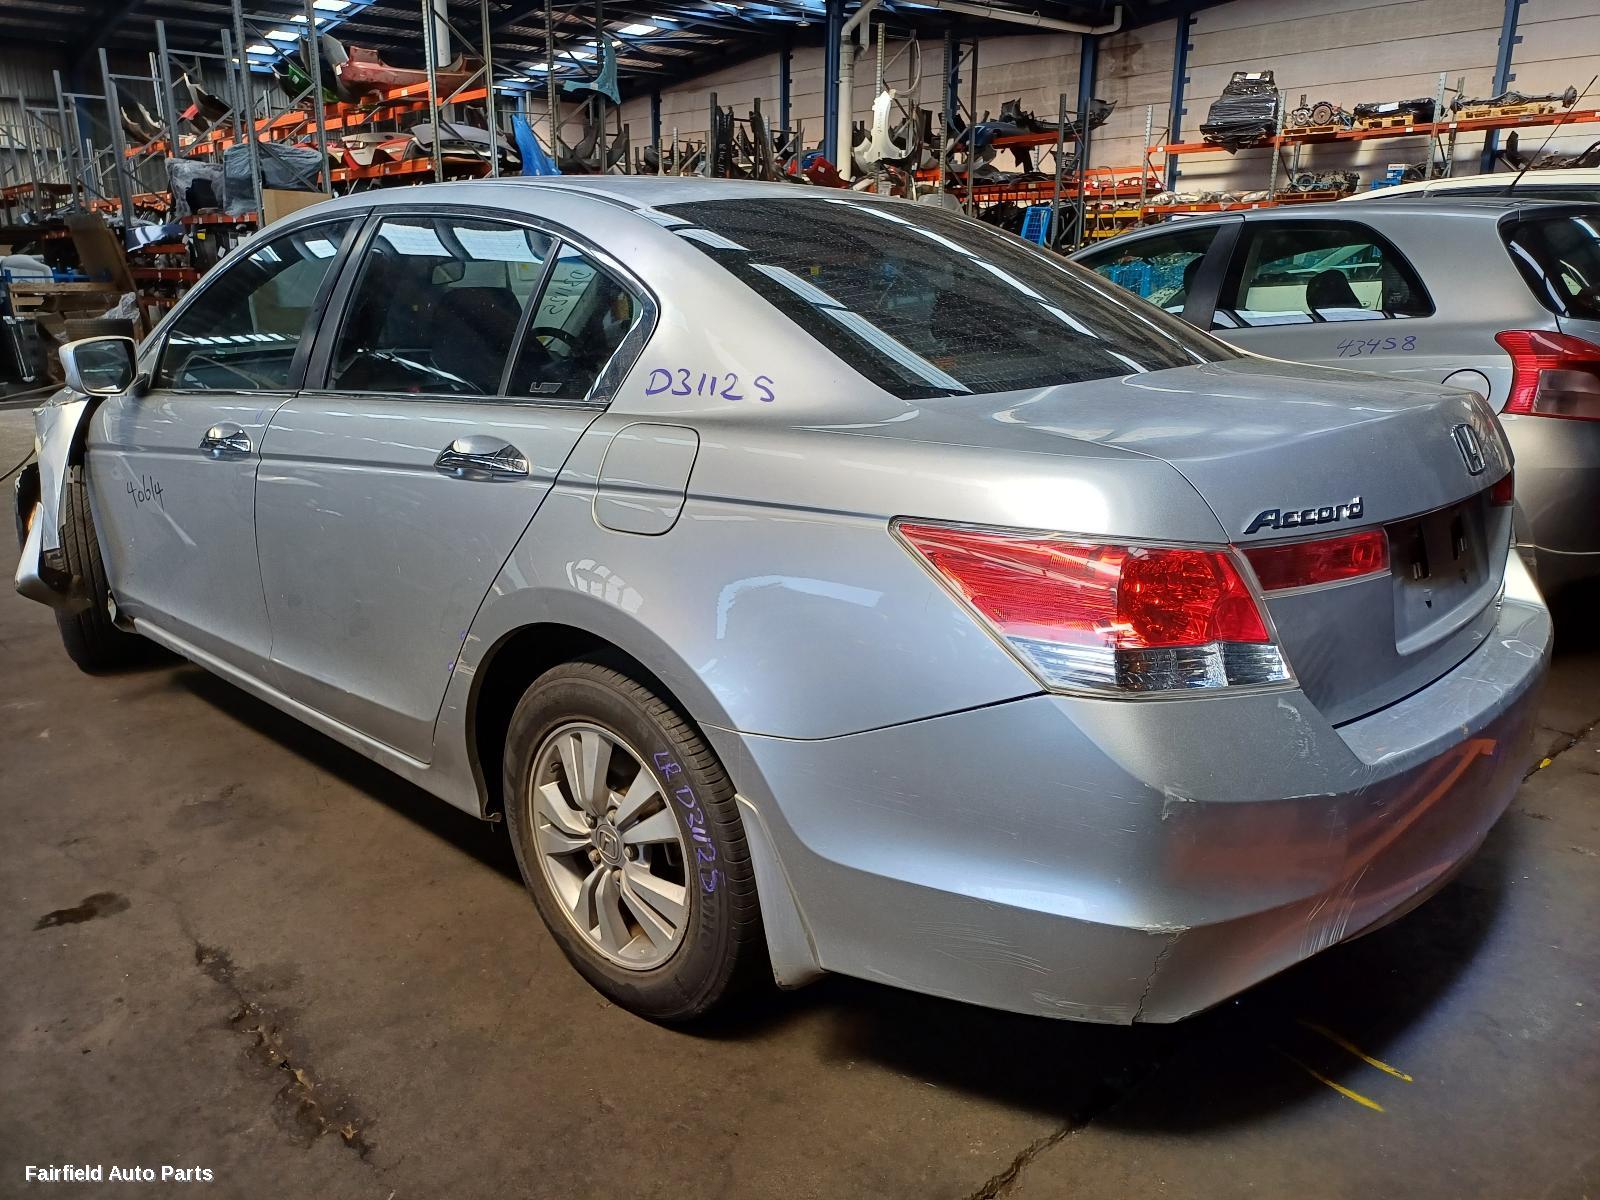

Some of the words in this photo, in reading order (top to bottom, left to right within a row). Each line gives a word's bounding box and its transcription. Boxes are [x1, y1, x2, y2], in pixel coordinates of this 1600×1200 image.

[1337, 336, 1417, 357] 43458
[126, 474, 165, 512] 40614
[1243, 496, 1364, 535] Accord
